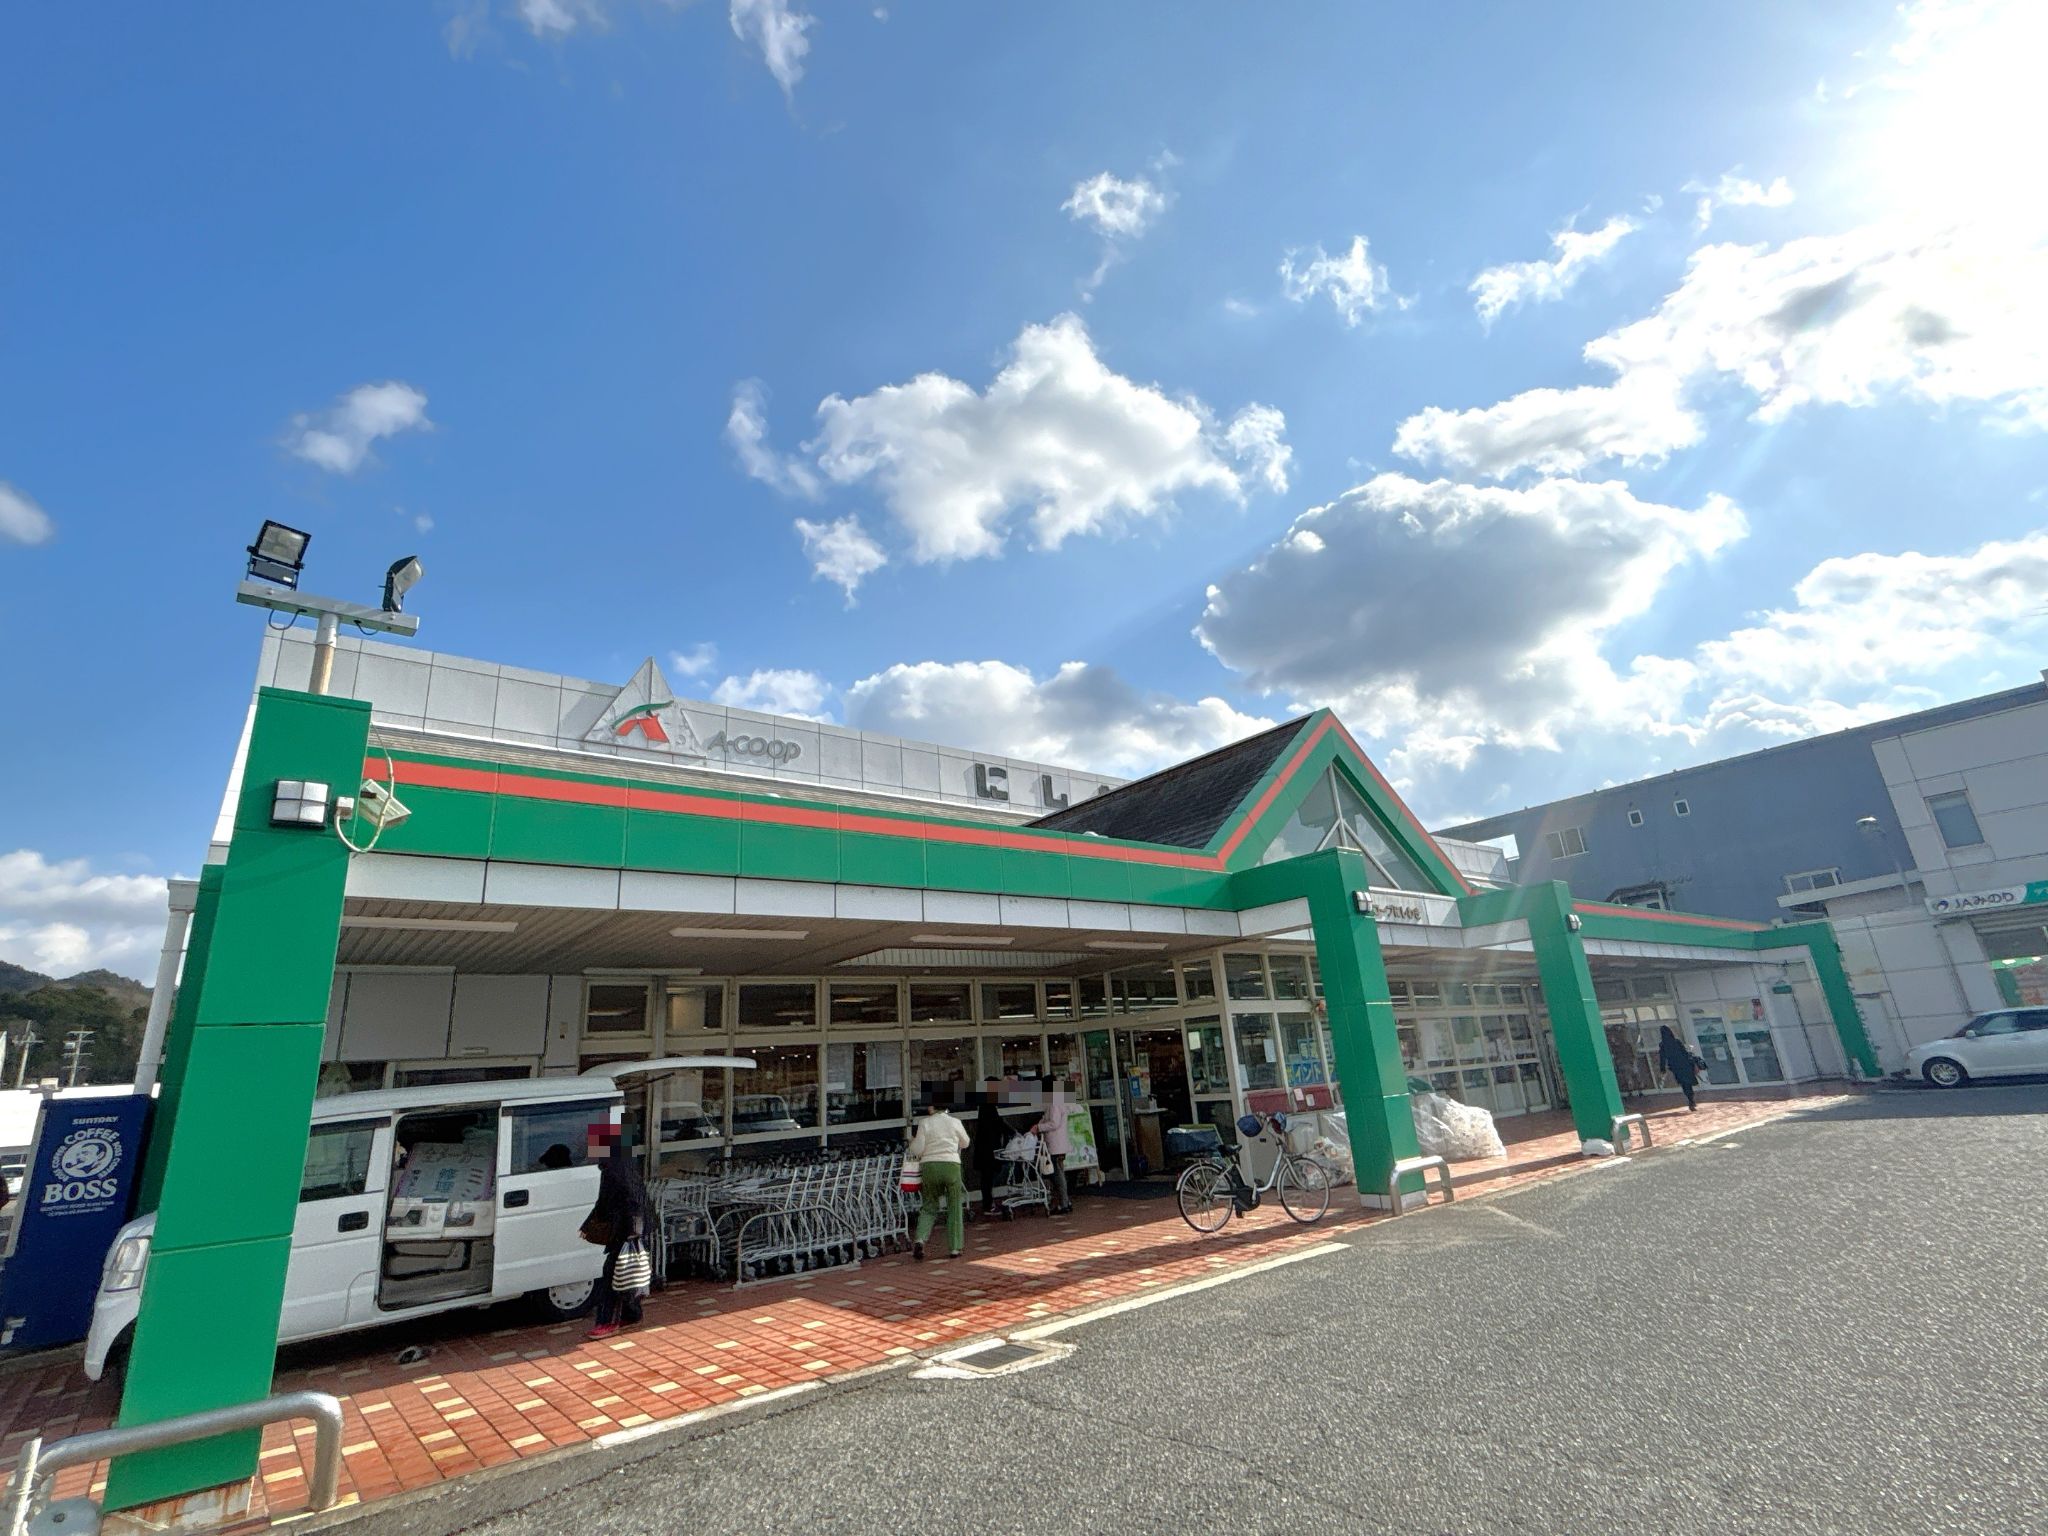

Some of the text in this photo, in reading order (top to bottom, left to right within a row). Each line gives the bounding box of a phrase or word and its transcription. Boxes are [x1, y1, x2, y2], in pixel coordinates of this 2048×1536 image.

[1955, 892, 2015, 909] JAみのり
[72, 1116, 119, 1125] SUNTORY
[63, 1127, 121, 1145] COFFEE
[41, 1178, 118, 1204] BOSS
